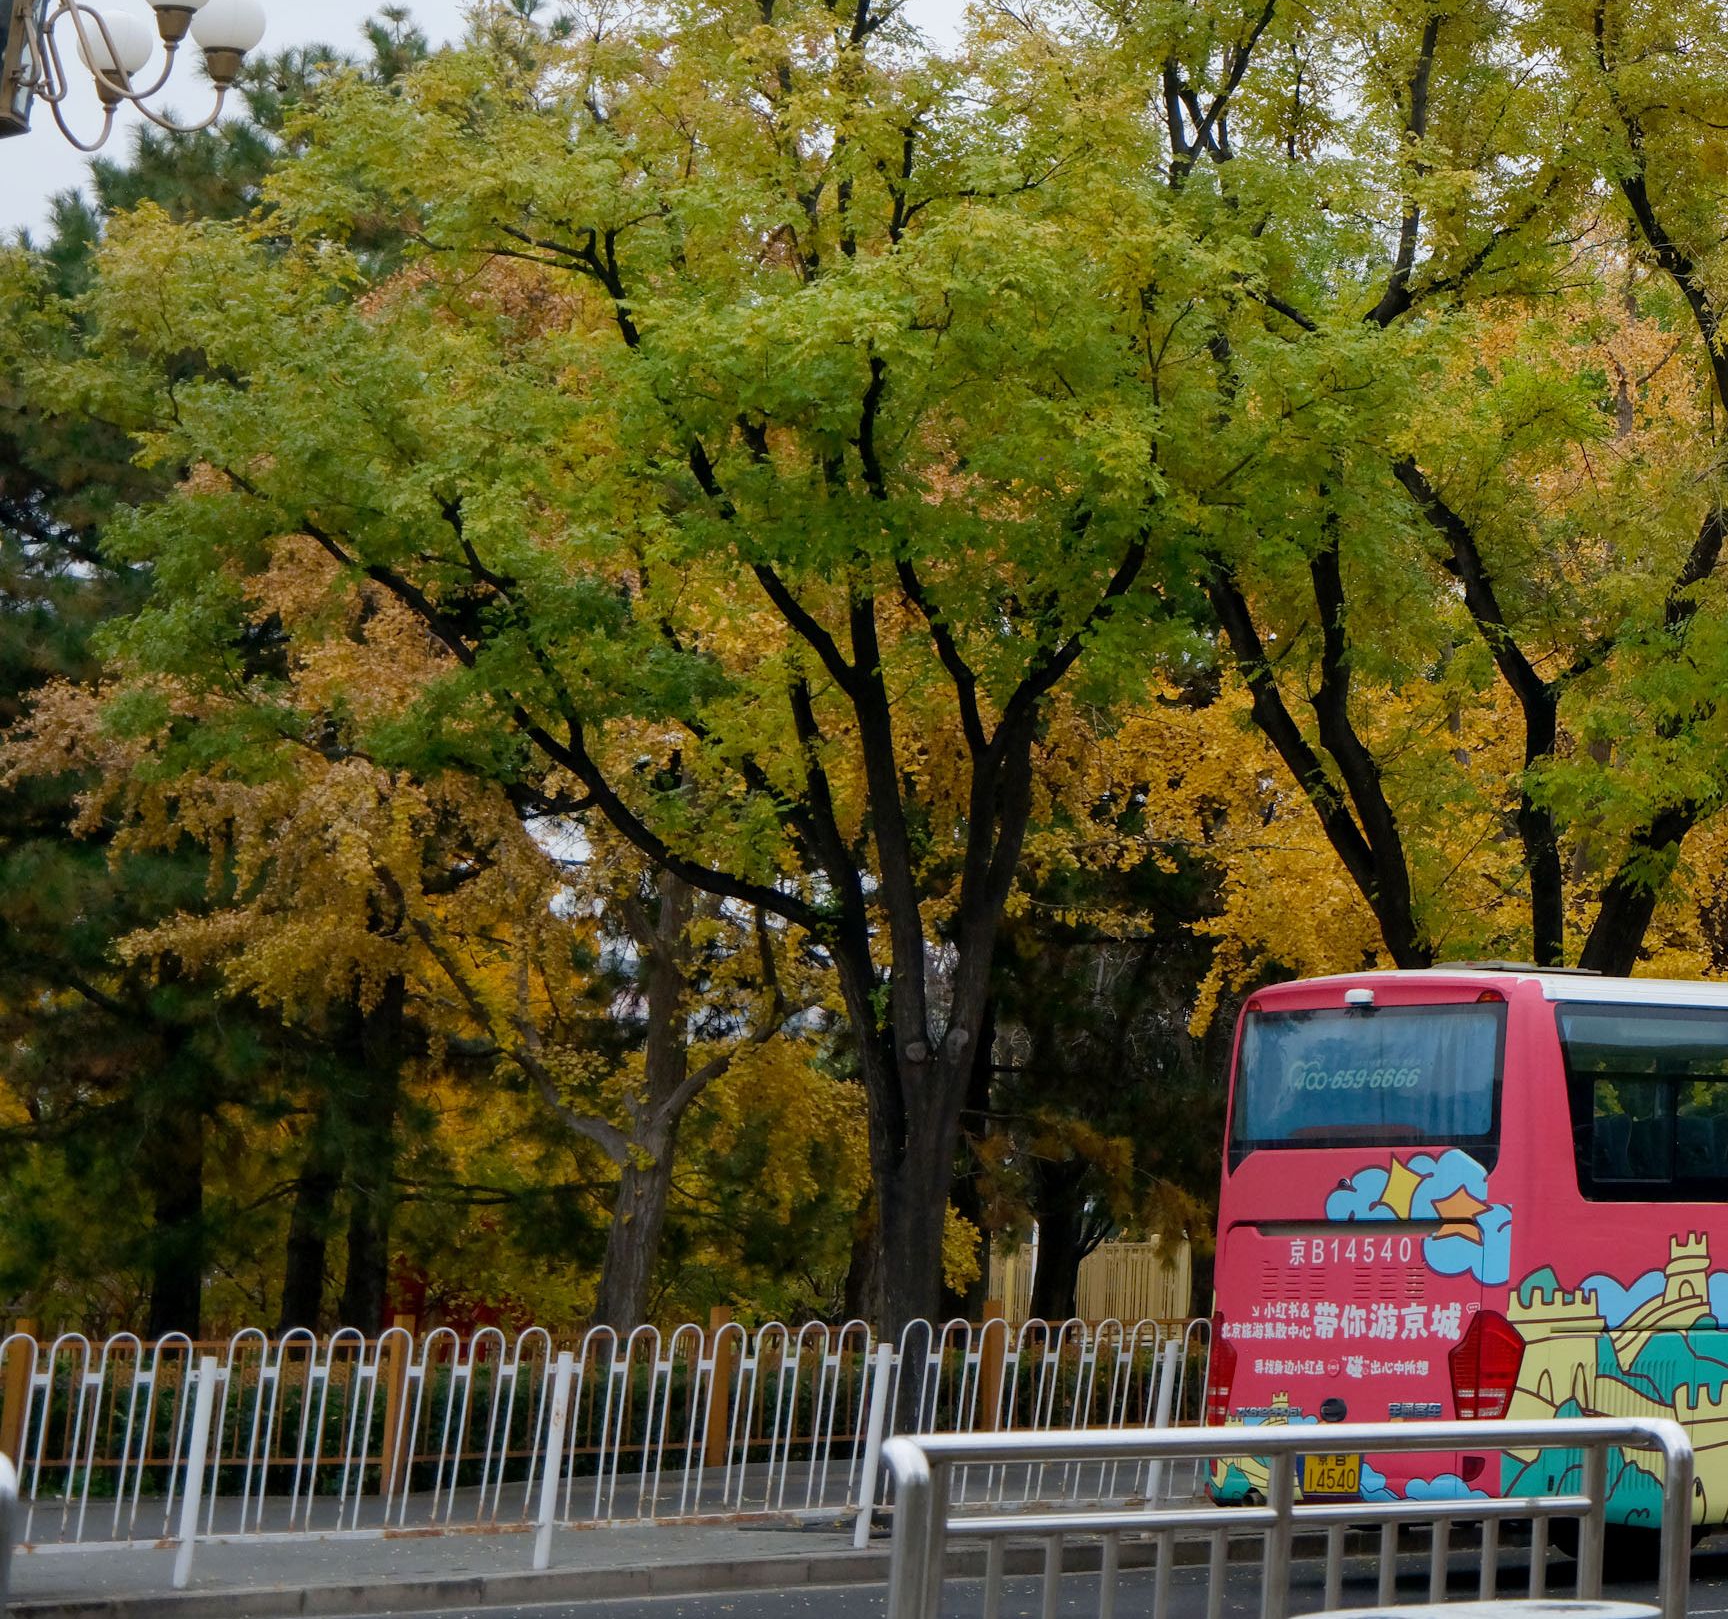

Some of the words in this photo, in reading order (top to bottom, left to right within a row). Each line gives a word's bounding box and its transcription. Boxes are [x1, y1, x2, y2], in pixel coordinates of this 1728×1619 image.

[1289, 1237, 1412, 1265] 京B14540
[1221, 1322, 1312, 1340] 北京旅游集散中心
[1314, 1302, 1462, 1340] 带你游京城
[1309, 1468, 1356, 1490] 14540
